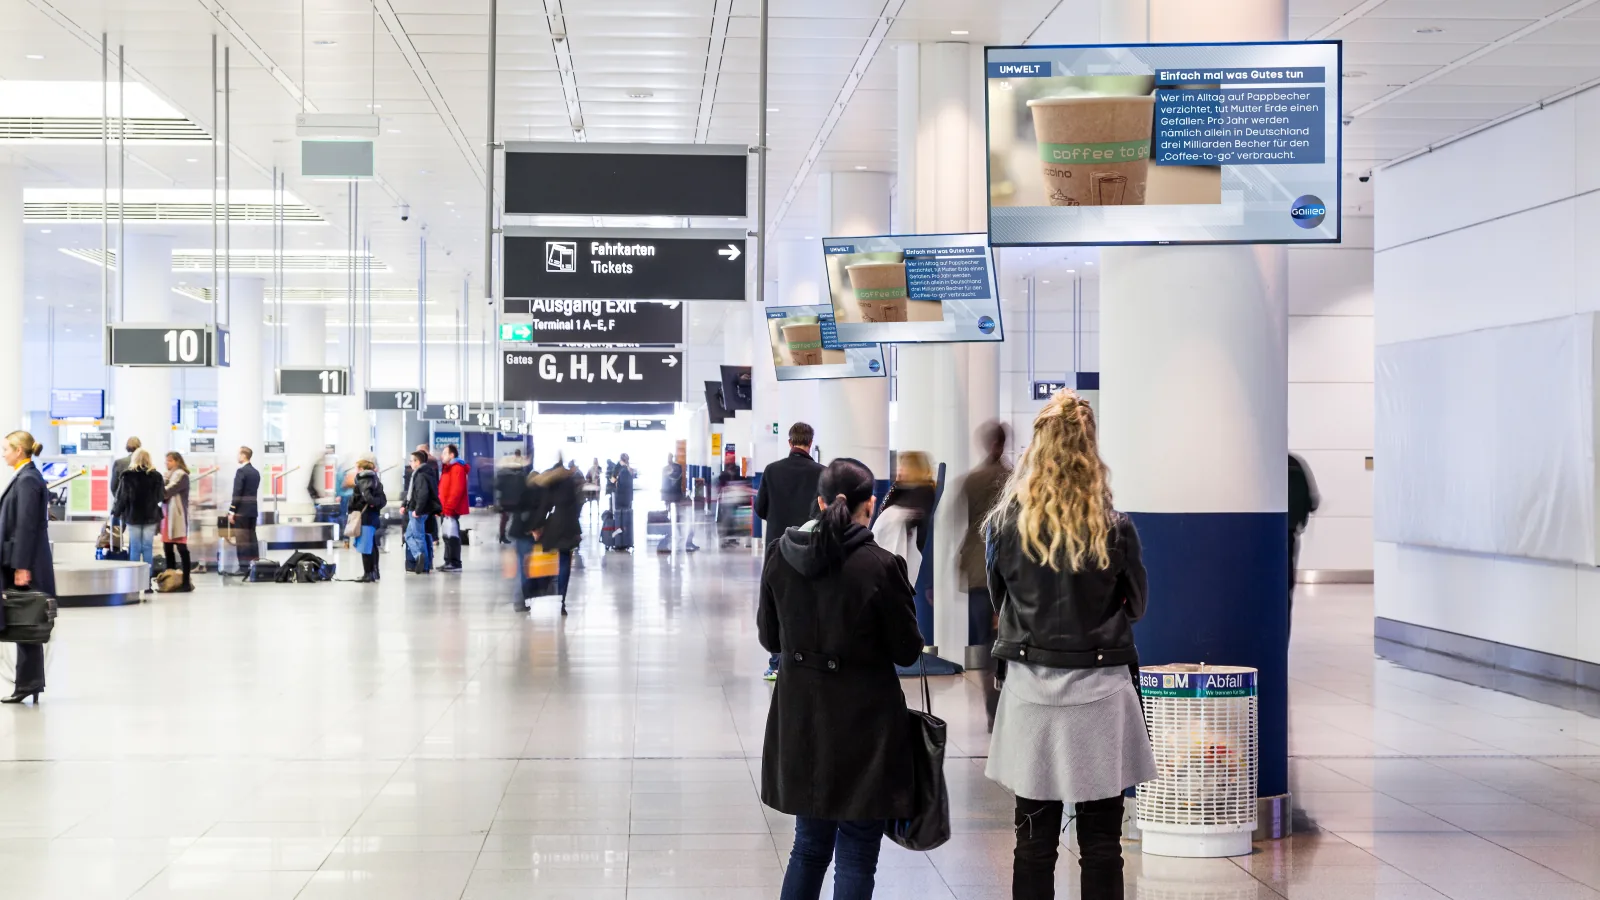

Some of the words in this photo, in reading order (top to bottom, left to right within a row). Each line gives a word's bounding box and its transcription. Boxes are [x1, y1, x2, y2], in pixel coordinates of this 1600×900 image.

[1000, 65, 1040, 74] UMWELT
[1160, 71, 1200, 81] Einfach
[1204, 71, 1223, 80] mal
[1251, 70, 1283, 79] Gutes
[1286, 70, 1304, 78] tun
[1160, 94, 1179, 102] Wer
[1182, 94, 1194, 102] im
[1196, 93, 1225, 103] Alltag
[1228, 93, 1245, 101] auf
[1247, 92, 1310, 102] Pappbecher
[1160, 105, 1212, 114] verzichtet,
[1214, 105, 1228, 113] tut
[1231, 105, 1262, 113] Mutter
[1265, 104, 1287, 112] Erde
[1290, 104, 1318, 112] einen
[1208, 117, 1224, 125] Pro
[1226, 116, 1248, 124] Jahr
[1250, 116, 1289, 124] werden
[1160, 129, 1201, 137] nämlich
[1204, 128, 1231, 136] allein
[1234, 128, 1242, 136] in
[1245, 127, 1309, 136] Deutschland
[1160, 140, 1181, 149] drei
[1183, 140, 1232, 148] Milliarden
[1234, 139, 1270, 148] Becher
[1272, 139, 1287, 147] für
[1289, 139, 1309, 147] den
[1053, 148, 1114, 160] coffee
[1120, 146, 1135, 157] to
[1237, 151, 1295, 160] verbraucht.
[591, 242, 655, 256] Fahrkarten
[591, 260, 633, 274] Tickets
[532, 300, 601, 316] Ausgang
[605, 300, 637, 313] Exit
[533, 319, 573, 330] Terminal
[575, 320, 581, 330] 1
[609, 320, 615, 330] F
[164, 330, 198, 362] 10
[506, 354, 533, 365] Gates
[539, 354, 563, 383] G,
[570, 354, 594, 383] H,
[601, 355, 624, 383] K,
[629, 355, 643, 380] L
[319, 370, 339, 393] 11
[395, 392, 412, 408] 12
[444, 404, 459, 419] 13
[477, 413, 490, 426] 14
[500, 420, 511, 431] 15
[1140, 674, 1158, 687] aste
[1206, 674, 1242, 688] Abfall
